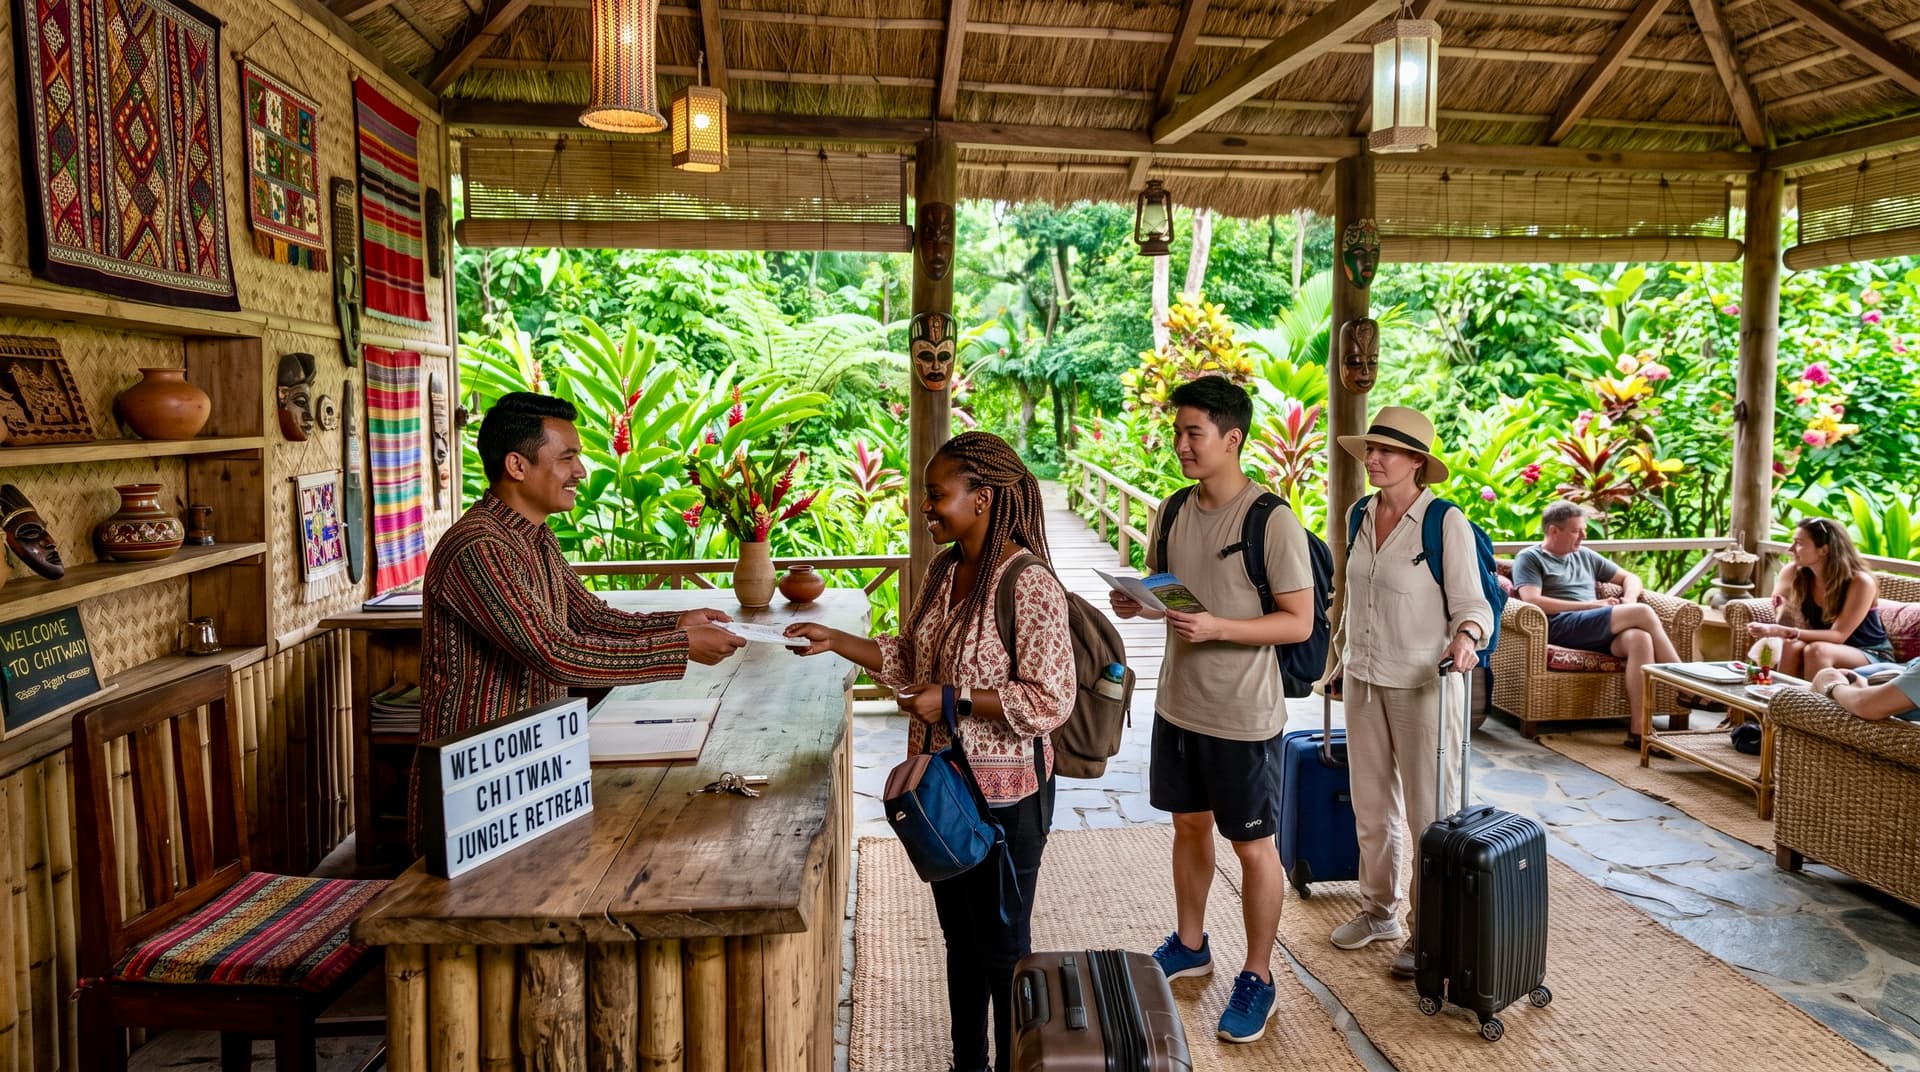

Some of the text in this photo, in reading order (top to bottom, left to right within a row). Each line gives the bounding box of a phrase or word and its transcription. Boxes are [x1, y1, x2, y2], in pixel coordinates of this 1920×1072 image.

[0, 618, 69, 652] WELCOME
[9, 657, 29, 678] TO
[451, 711, 578, 780] WELCOME TO
[476, 754, 572, 812] CHITWAN-
[457, 780, 590, 864] JUNGLE RETREAT
